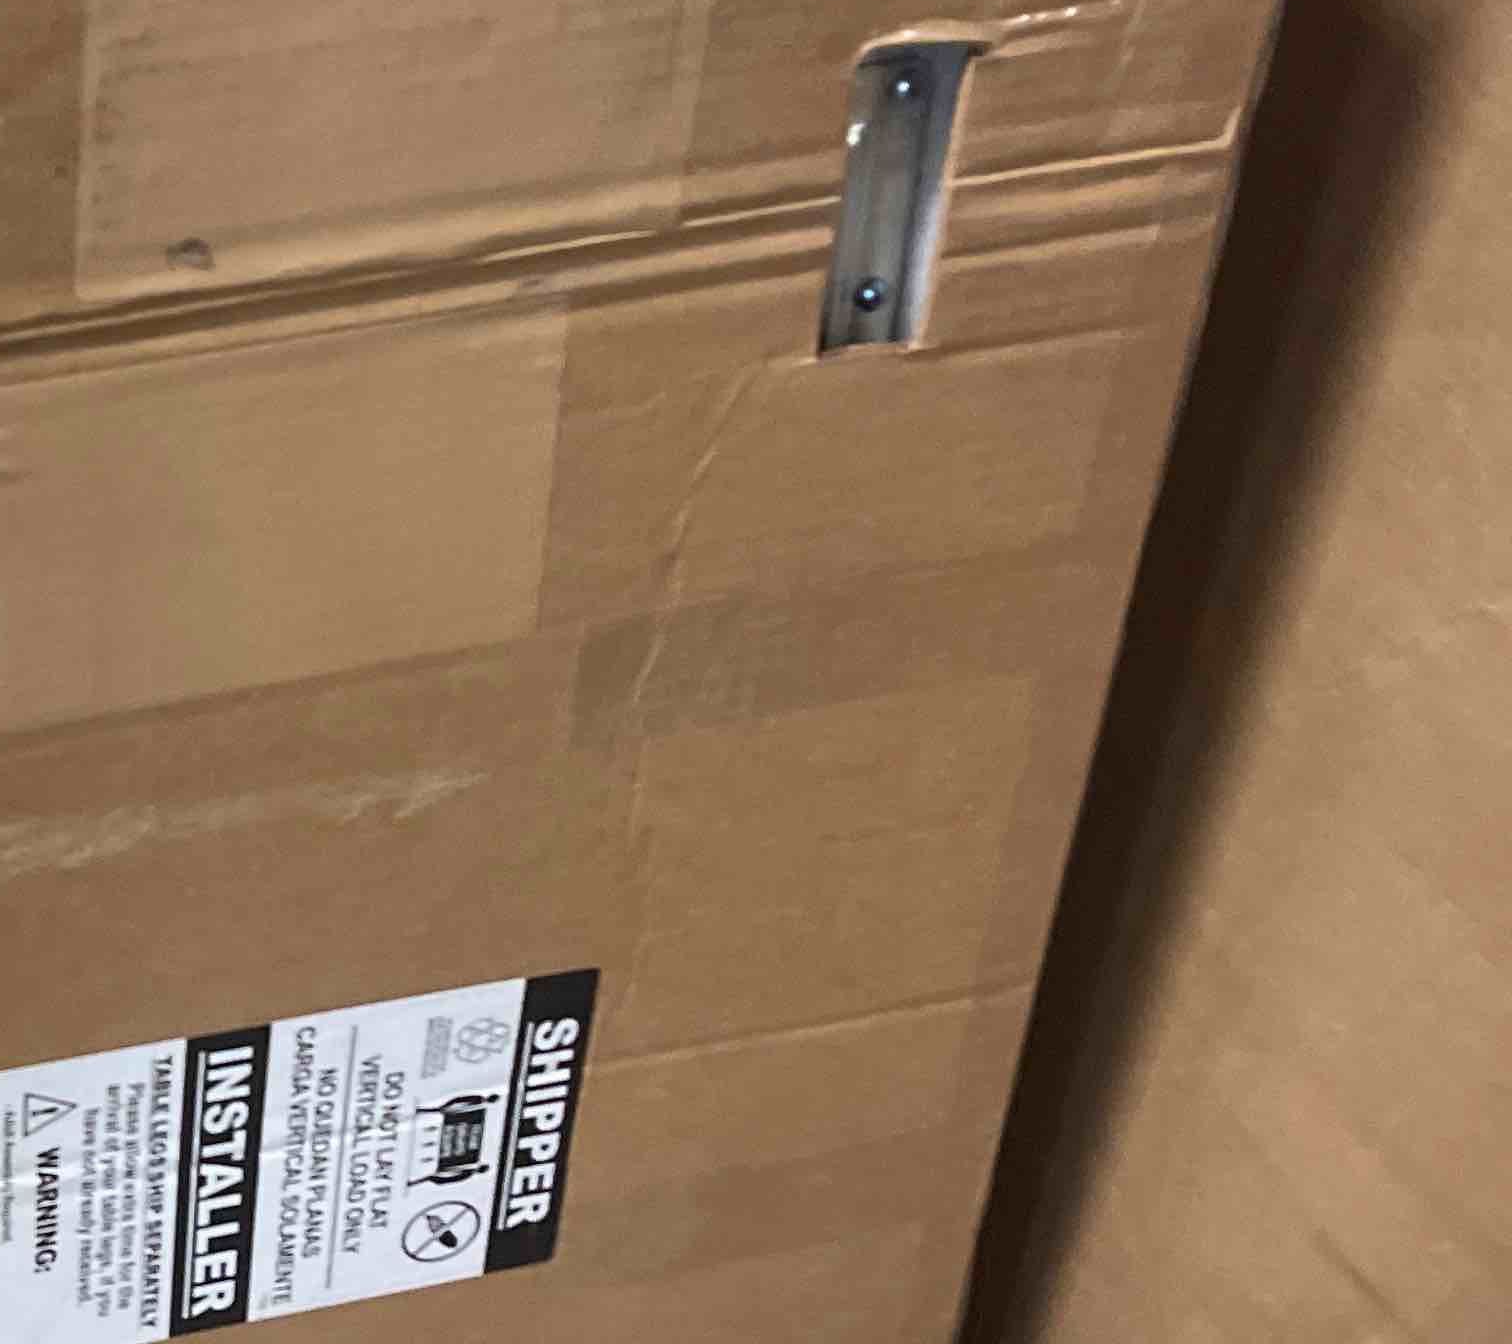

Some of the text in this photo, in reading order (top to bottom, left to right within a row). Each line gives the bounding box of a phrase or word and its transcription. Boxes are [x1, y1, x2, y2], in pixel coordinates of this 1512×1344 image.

[290, 1024, 317, 1096] CARGA
[382, 1069, 405, 1101] DO
[281, 1098, 310, 1190] VERTICAL
[339, 1054, 381, 1256] VERTICAL LOAD ONLY
[373, 1145, 396, 1182] LAY
[503, 1013, 582, 1230] SHIPPER
[33, 1146, 59, 1275] WARNING:
[139, 1054, 172, 1330] TABLE LEGS SHIP SEPARATELY
[189, 1043, 255, 1317] INSTALLER
[300, 1183, 326, 1260] PLANAS
[368, 1183, 392, 1231] FLAT
